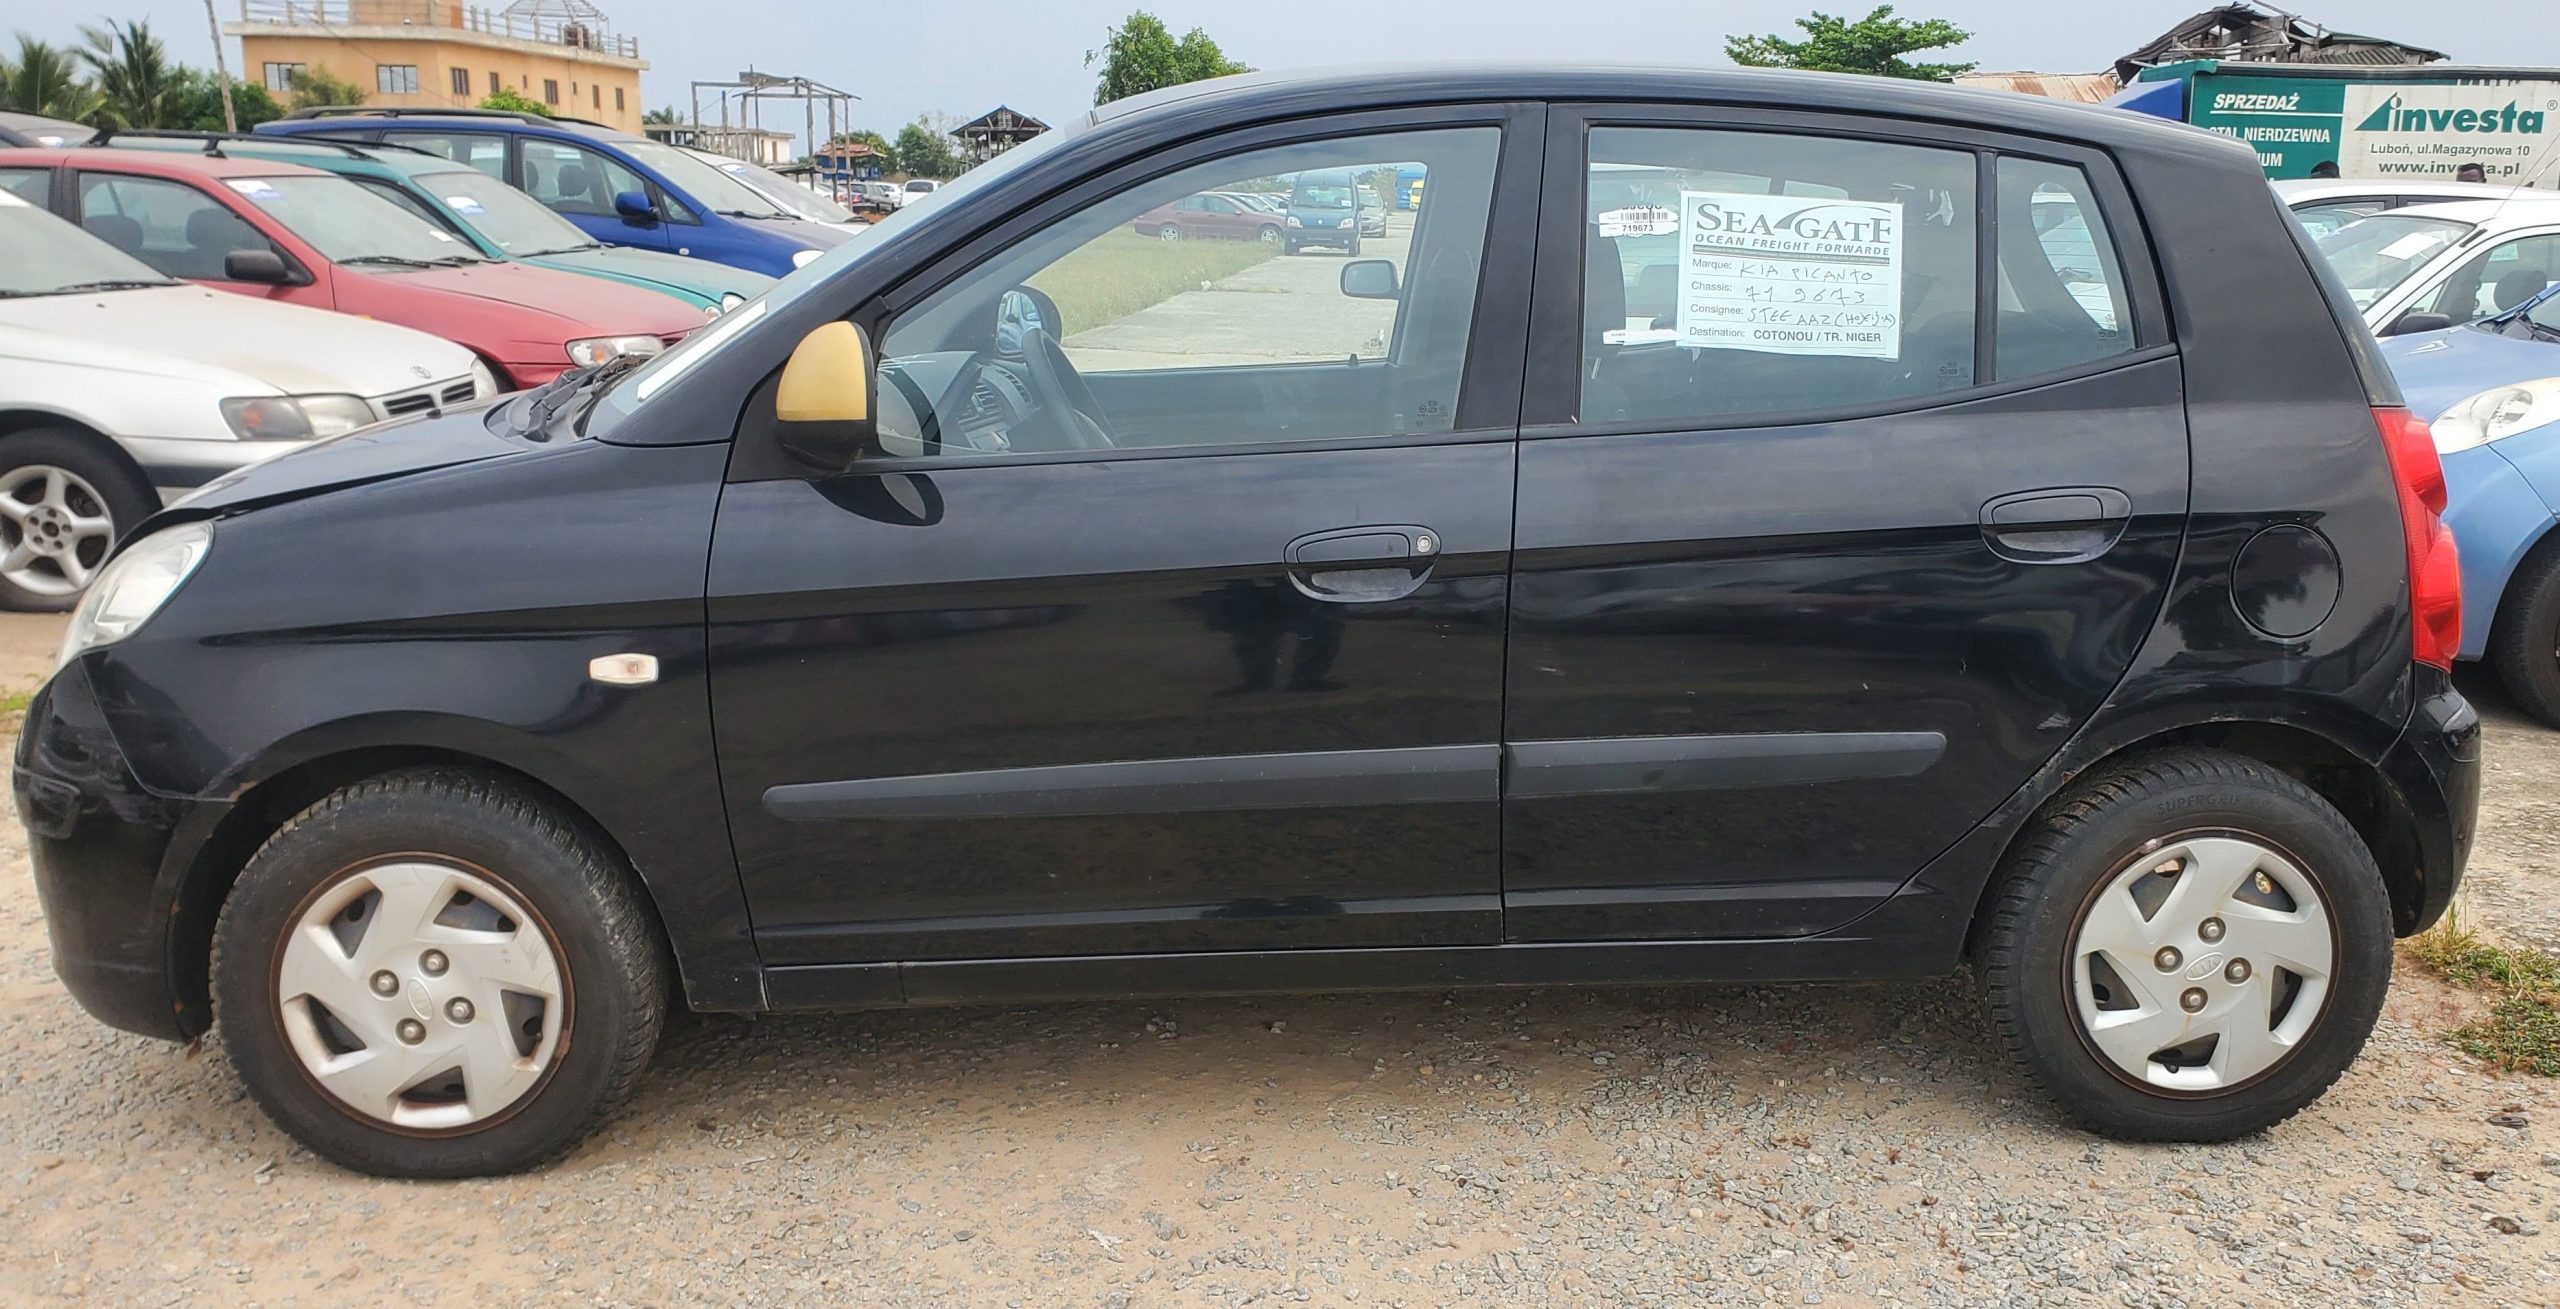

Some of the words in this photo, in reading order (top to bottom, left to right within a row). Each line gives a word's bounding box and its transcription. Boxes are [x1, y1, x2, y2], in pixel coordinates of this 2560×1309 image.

[2213, 92, 2300, 110] SPRZEDAŻ
[2388, 95, 2545, 134] investa
[2244, 127, 2331, 143] NIERDZEWNA
[2370, 143, 2413, 155] Luboń,
[2417, 143, 2512, 157] ul.Magazynowa
[2516, 145, 2530, 156] 10
[2378, 161, 2520, 177] www.inva.pl
[1622, 224, 1654, 232] 719673
[1696, 203, 1774, 236] SEA
[1794, 217, 1891, 244] GATE
[1695, 233, 1745, 246] OCEAN
[1752, 238, 1810, 252] FREIGHT
[1816, 243, 1890, 256] FORWARDE
[1692, 258, 1732, 271] Marque:
[1691, 280, 1732, 292] Chassis:
[1690, 303, 1744, 316] Consignee:
[1689, 326, 1745, 338] Destination:
[1753, 329, 1813, 341] COTONOU
[1824, 332, 1843, 342] TR.
[1846, 332, 1882, 342] NIGER
